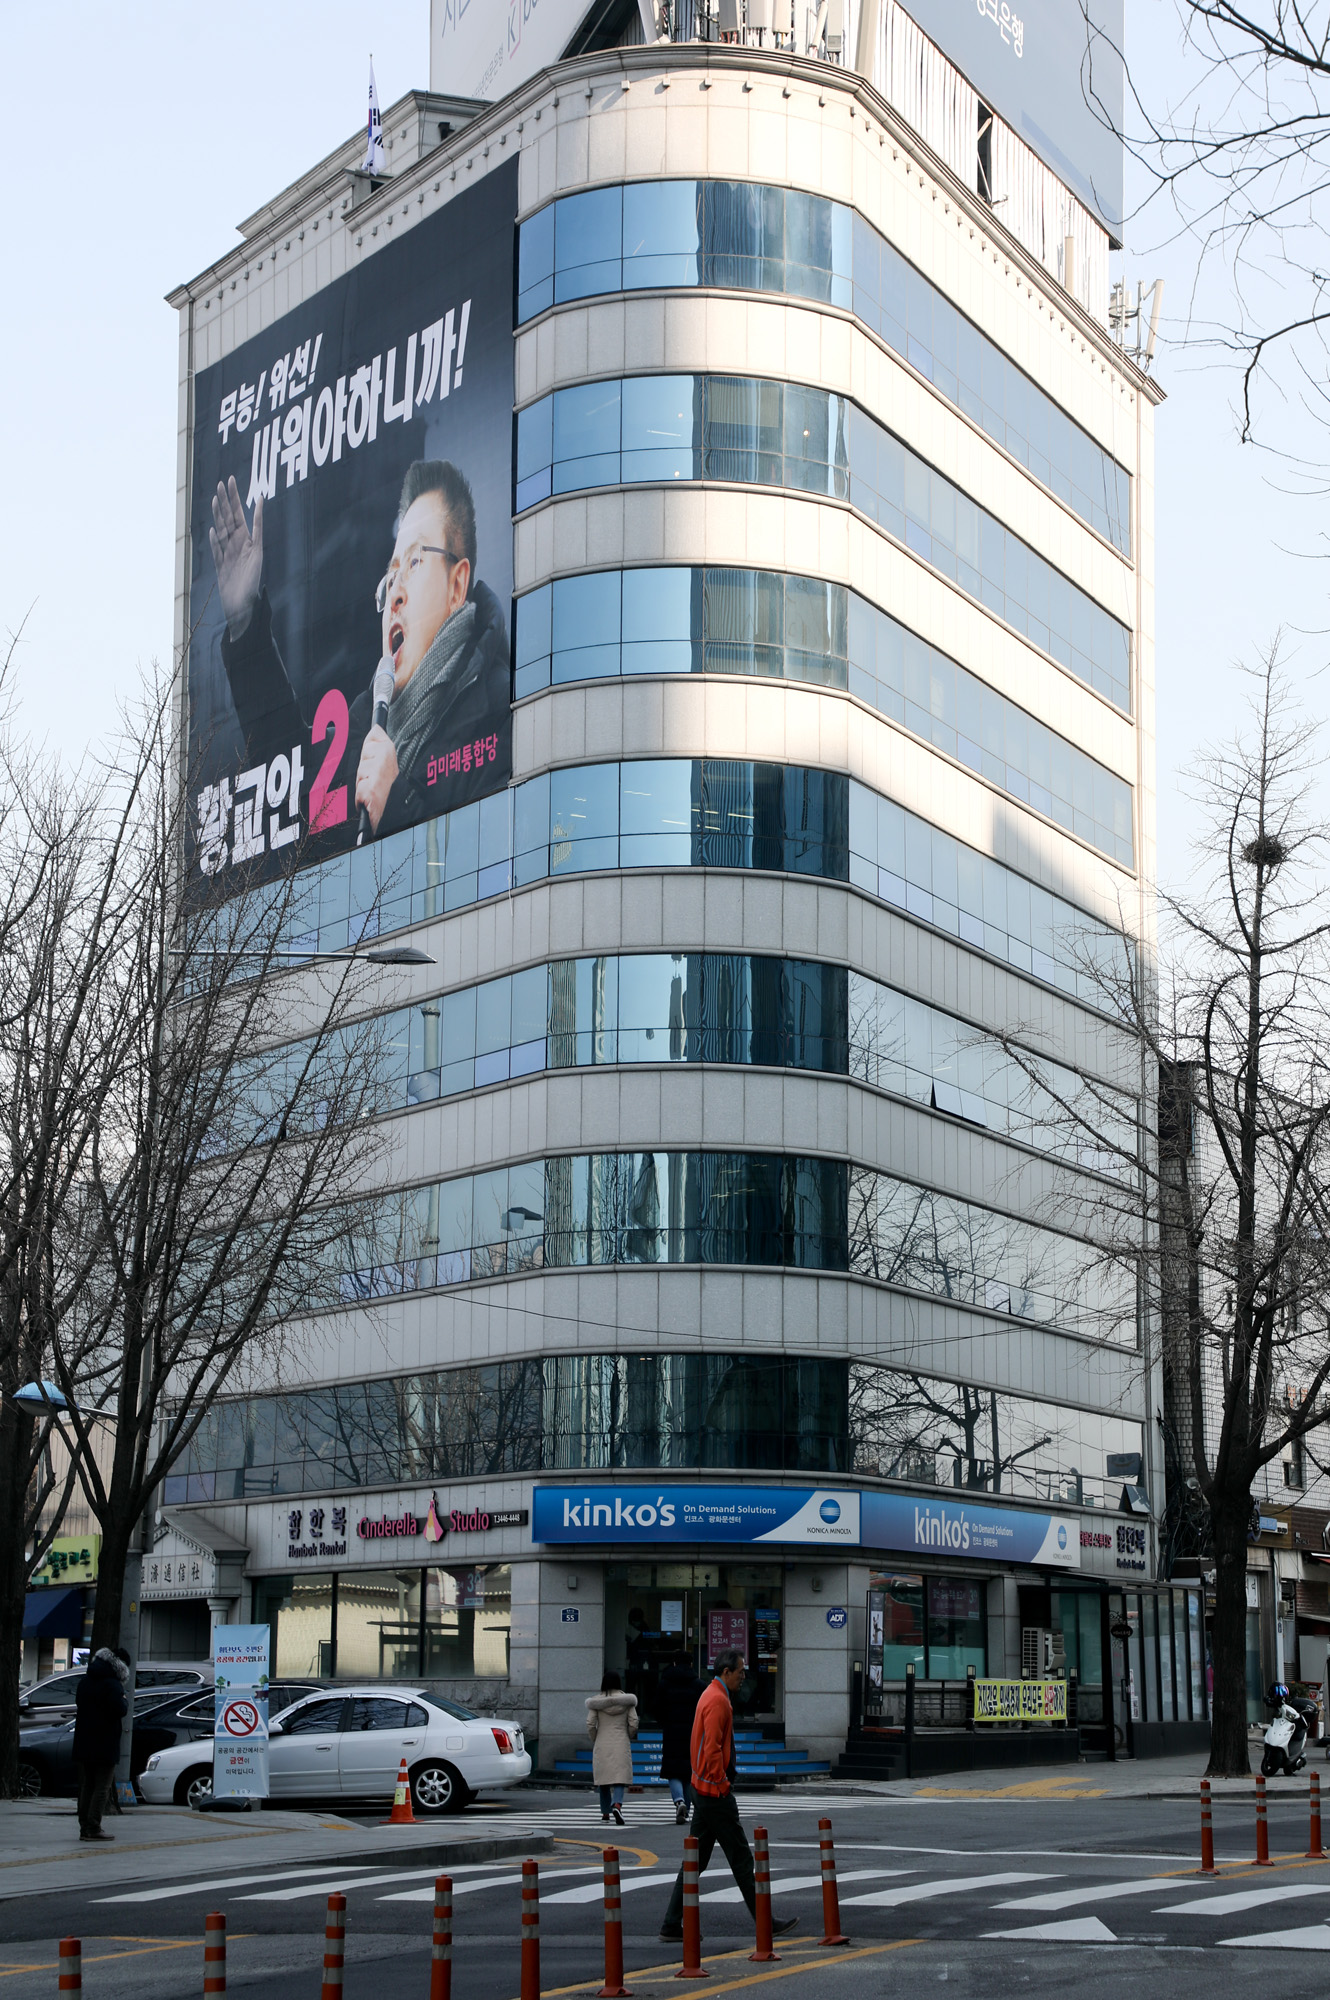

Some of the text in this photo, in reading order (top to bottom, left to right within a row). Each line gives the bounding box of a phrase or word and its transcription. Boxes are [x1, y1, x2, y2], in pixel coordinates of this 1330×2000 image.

[218, 333, 323, 445] 무능! 위선!
[246, 298, 472, 509] 싸워야하니까!
[438, 733, 499, 778] 미래통합당
[197, 688, 350, 877] 황교안 2
[563, 1496, 676, 1527] kinko's
[683, 1504, 777, 1515] On Demand Solutions
[359, 1507, 490, 1540] Cinderella Studio
[684, 1515, 741, 1524] 킨코스 광화문센터
[915, 1506, 970, 1550] kinko's
[972, 1523, 1014, 1537] On Demand Solutions
[288, 1541, 346, 1558] Hanbok Rental
[566, 1614, 575, 1622] 55
[829, 1614, 845, 1623] ADT
[218, 1746, 264, 1755] 공공의 공간에서는
[230, 1756, 250, 1765] 금연이
